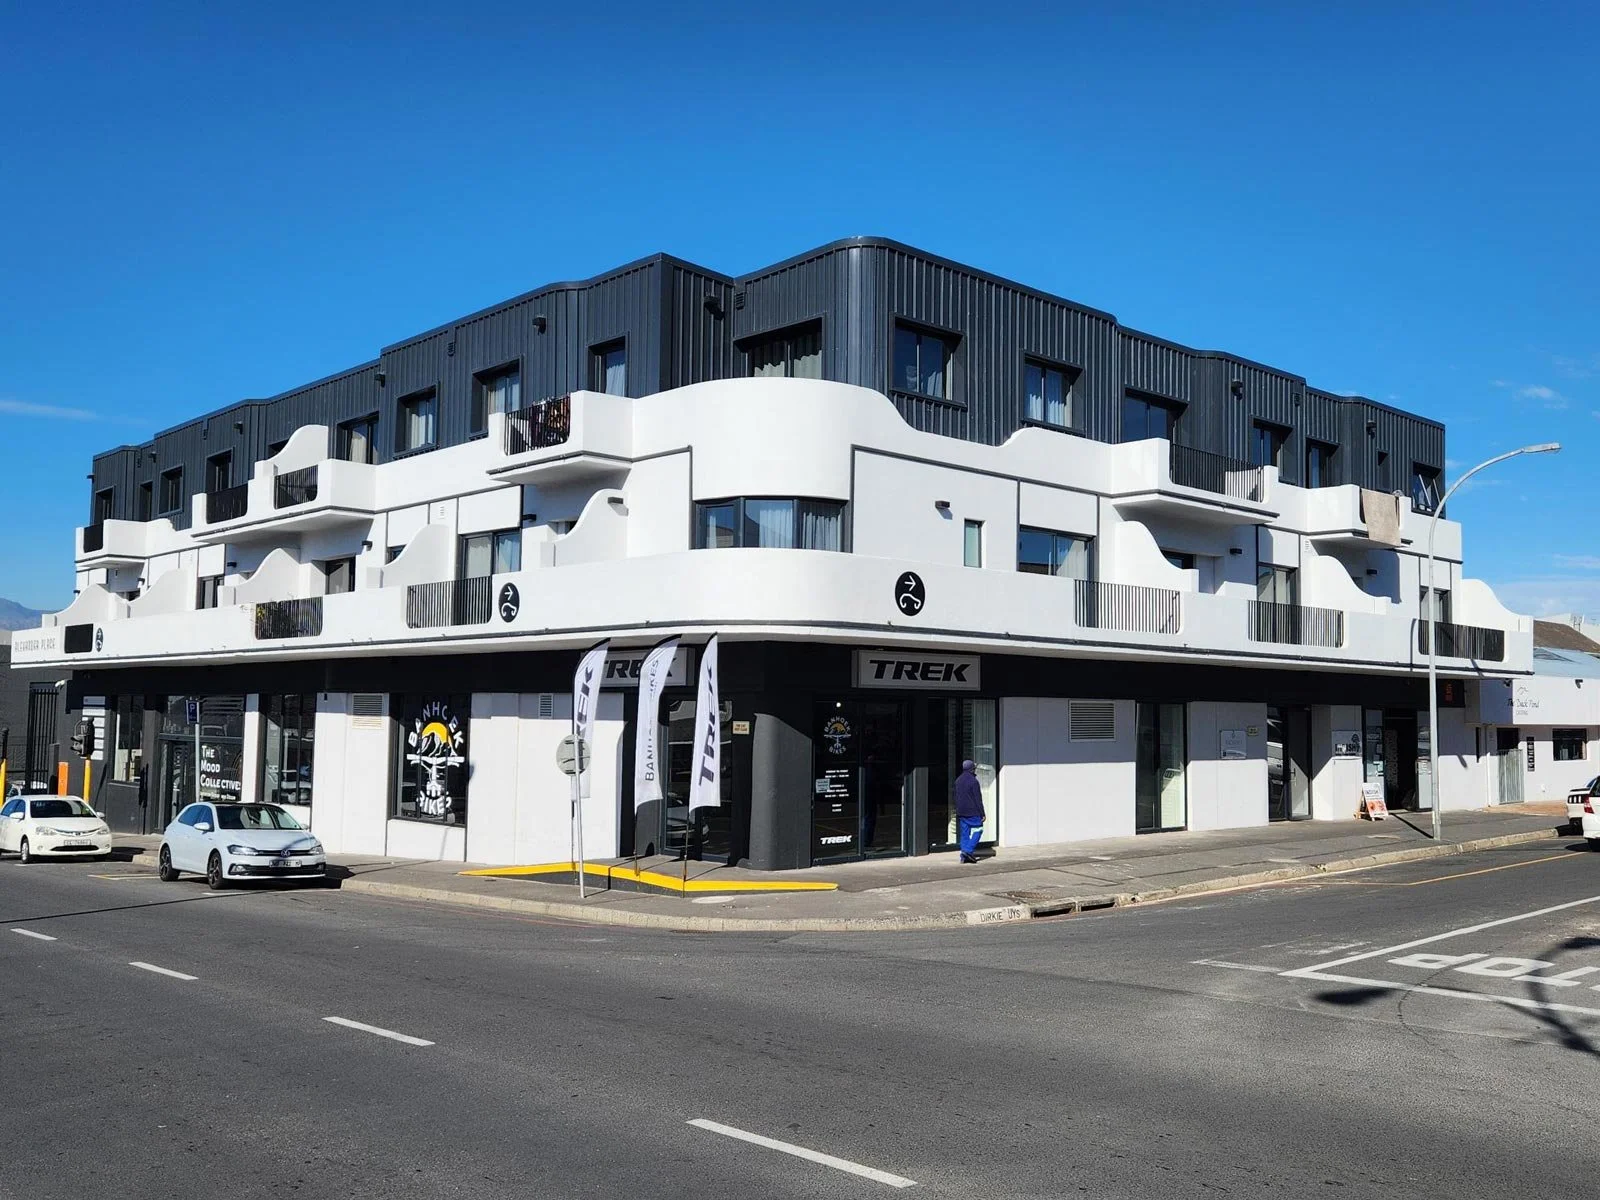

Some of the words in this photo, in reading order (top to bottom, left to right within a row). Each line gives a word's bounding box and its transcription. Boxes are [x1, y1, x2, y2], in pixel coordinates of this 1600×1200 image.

[604, 657, 677, 679] RE
[869, 659, 972, 682] TREK
[698, 660, 716, 787] TREK
[201, 745, 215, 758] THE
[200, 760, 221, 773] MOOD
[820, 835, 853, 845] TREK
[980, 911, 1004, 923] DIRKIE
[1007, 908, 1021, 920] UYS
[1387, 952, 1600, 991] TOP
